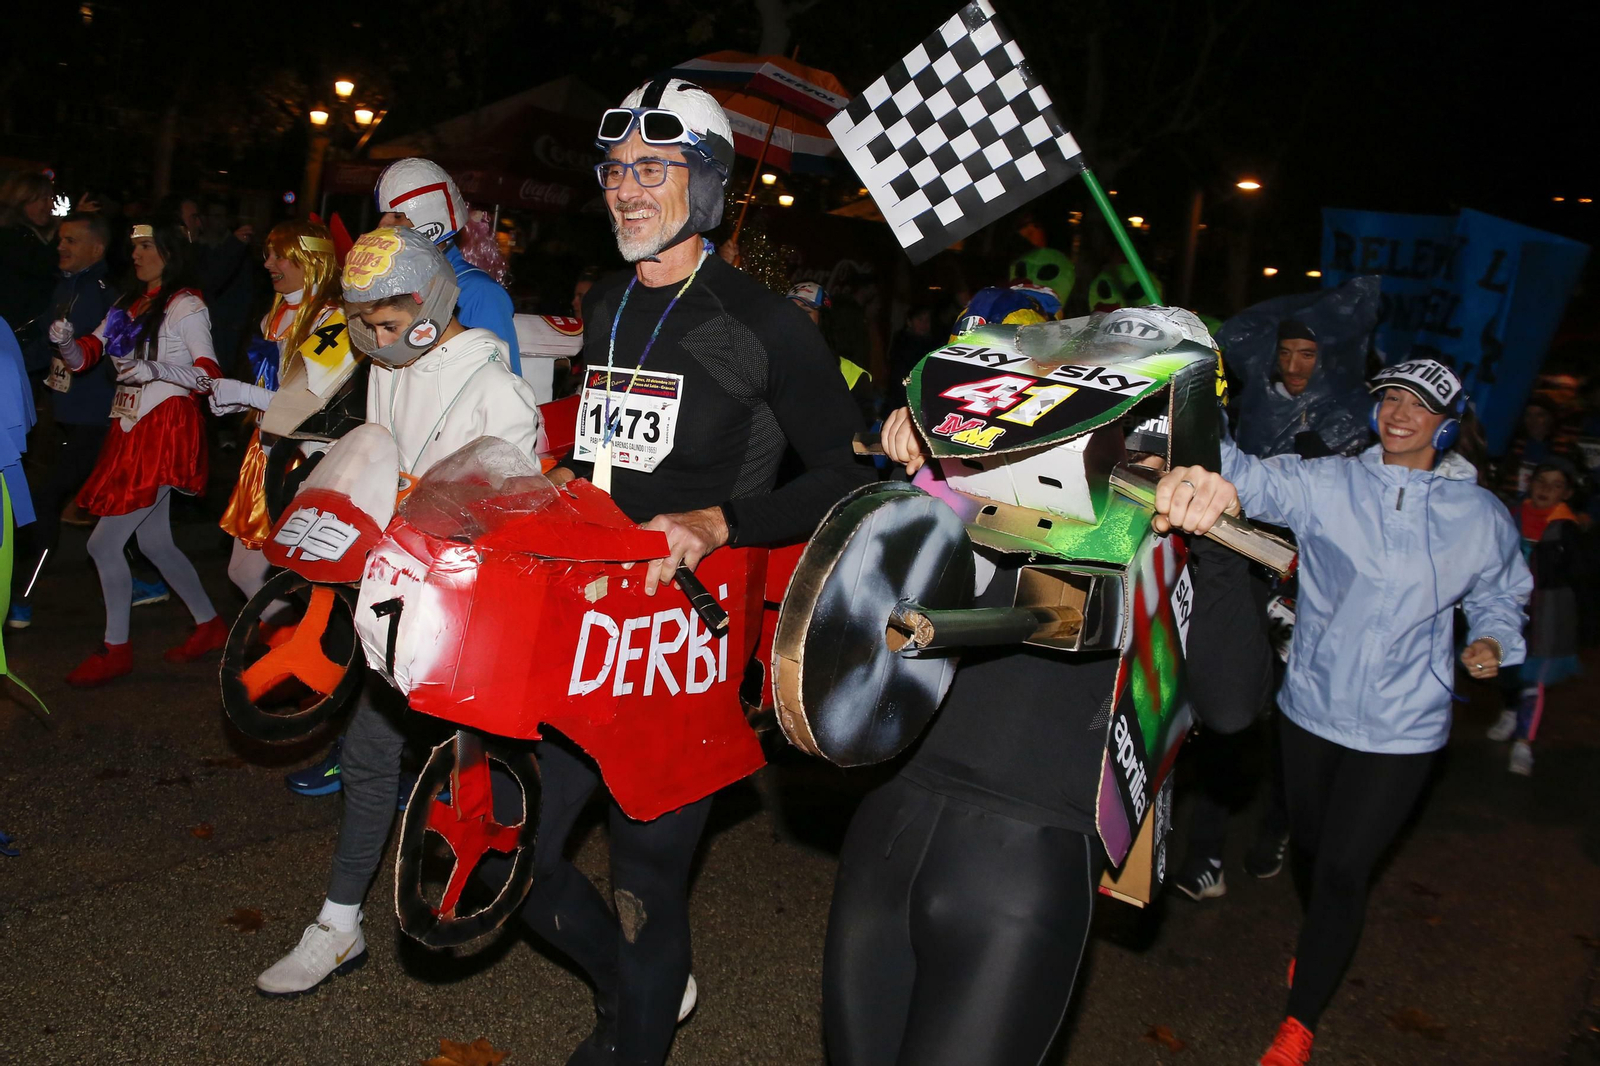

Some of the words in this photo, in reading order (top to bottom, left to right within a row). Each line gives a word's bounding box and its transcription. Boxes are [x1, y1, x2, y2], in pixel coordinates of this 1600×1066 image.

[772, 72, 836, 104] REPSOL
[313, 322, 347, 356] 4
[938, 373, 1079, 427] 41
[1380, 362, 1454, 400] aprilia
[589, 404, 660, 443] 1473
[931, 412, 1006, 451] MM
[1114, 714, 1147, 825] aprilia
